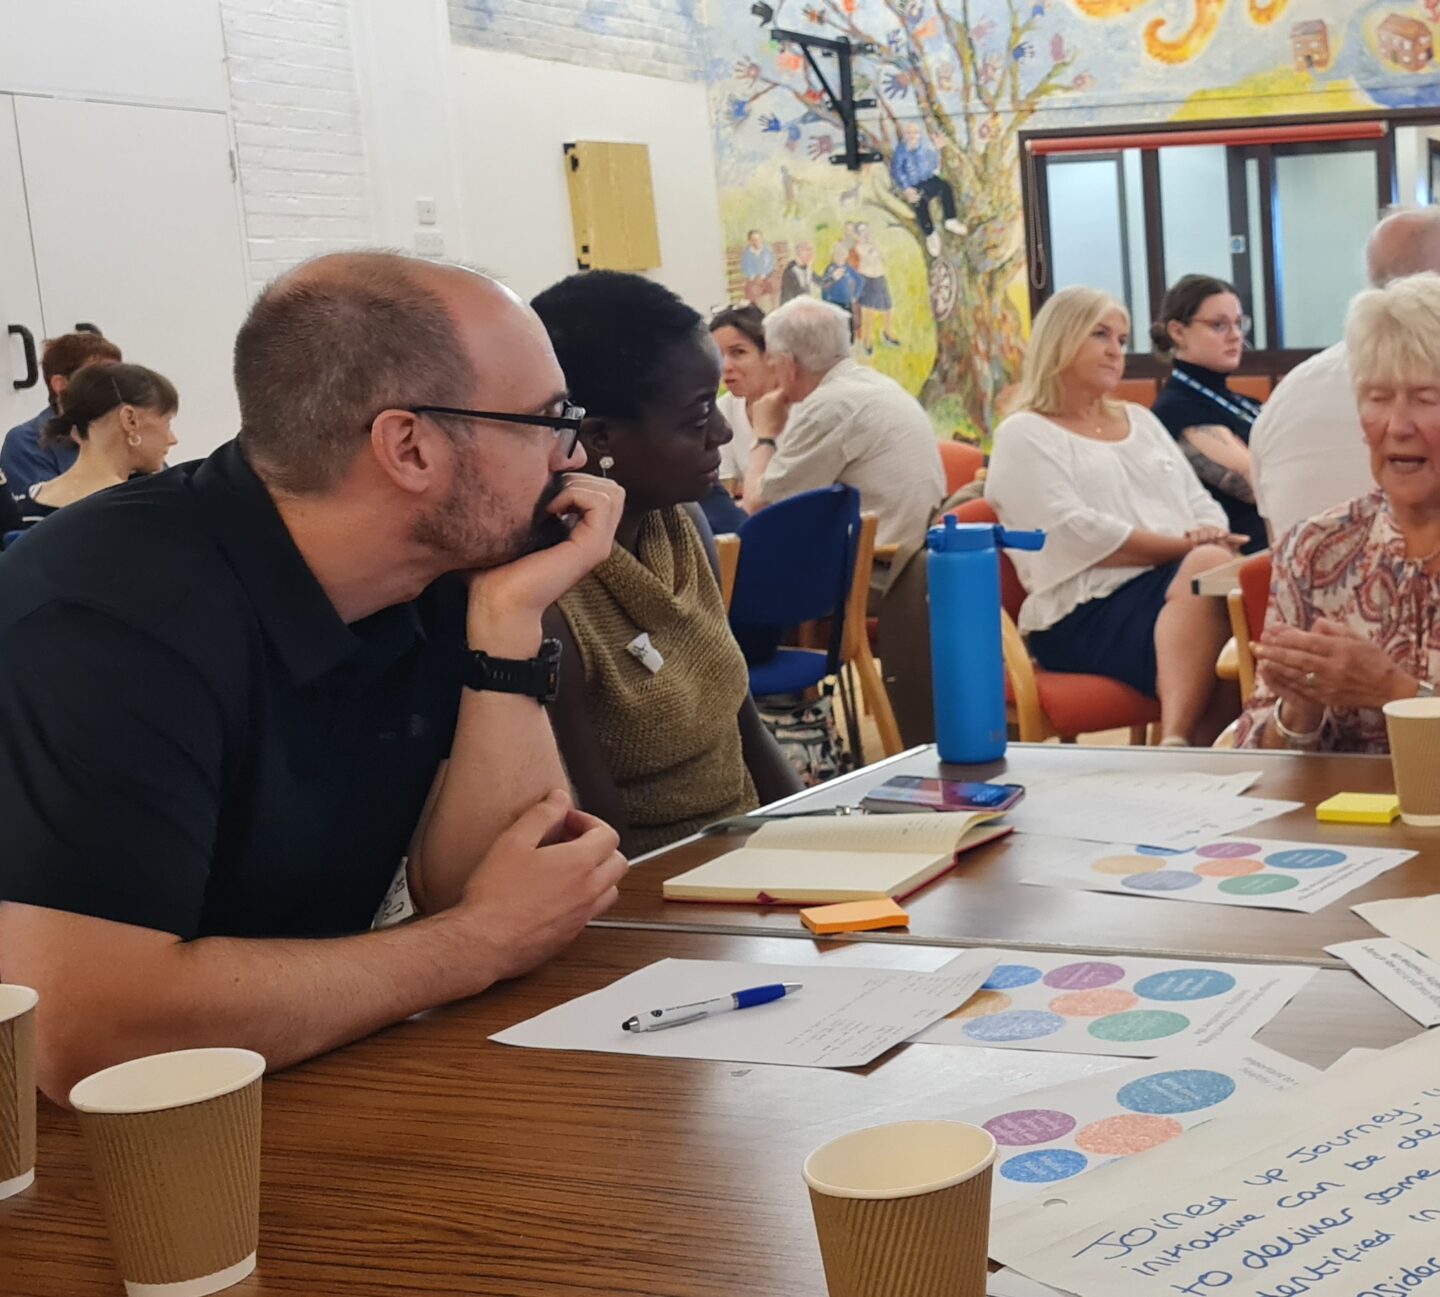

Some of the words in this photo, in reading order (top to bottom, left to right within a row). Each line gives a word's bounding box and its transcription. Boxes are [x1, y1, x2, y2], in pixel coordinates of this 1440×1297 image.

[1072, 1196, 1237, 1260] Joined
[1243, 1168, 1288, 1186] up
[1120, 1213, 1265, 1276] initiative
[1277, 1181, 1345, 1208] can
[1344, 1153, 1386, 1171] be
[1242, 1208, 1354, 1269] deliver
